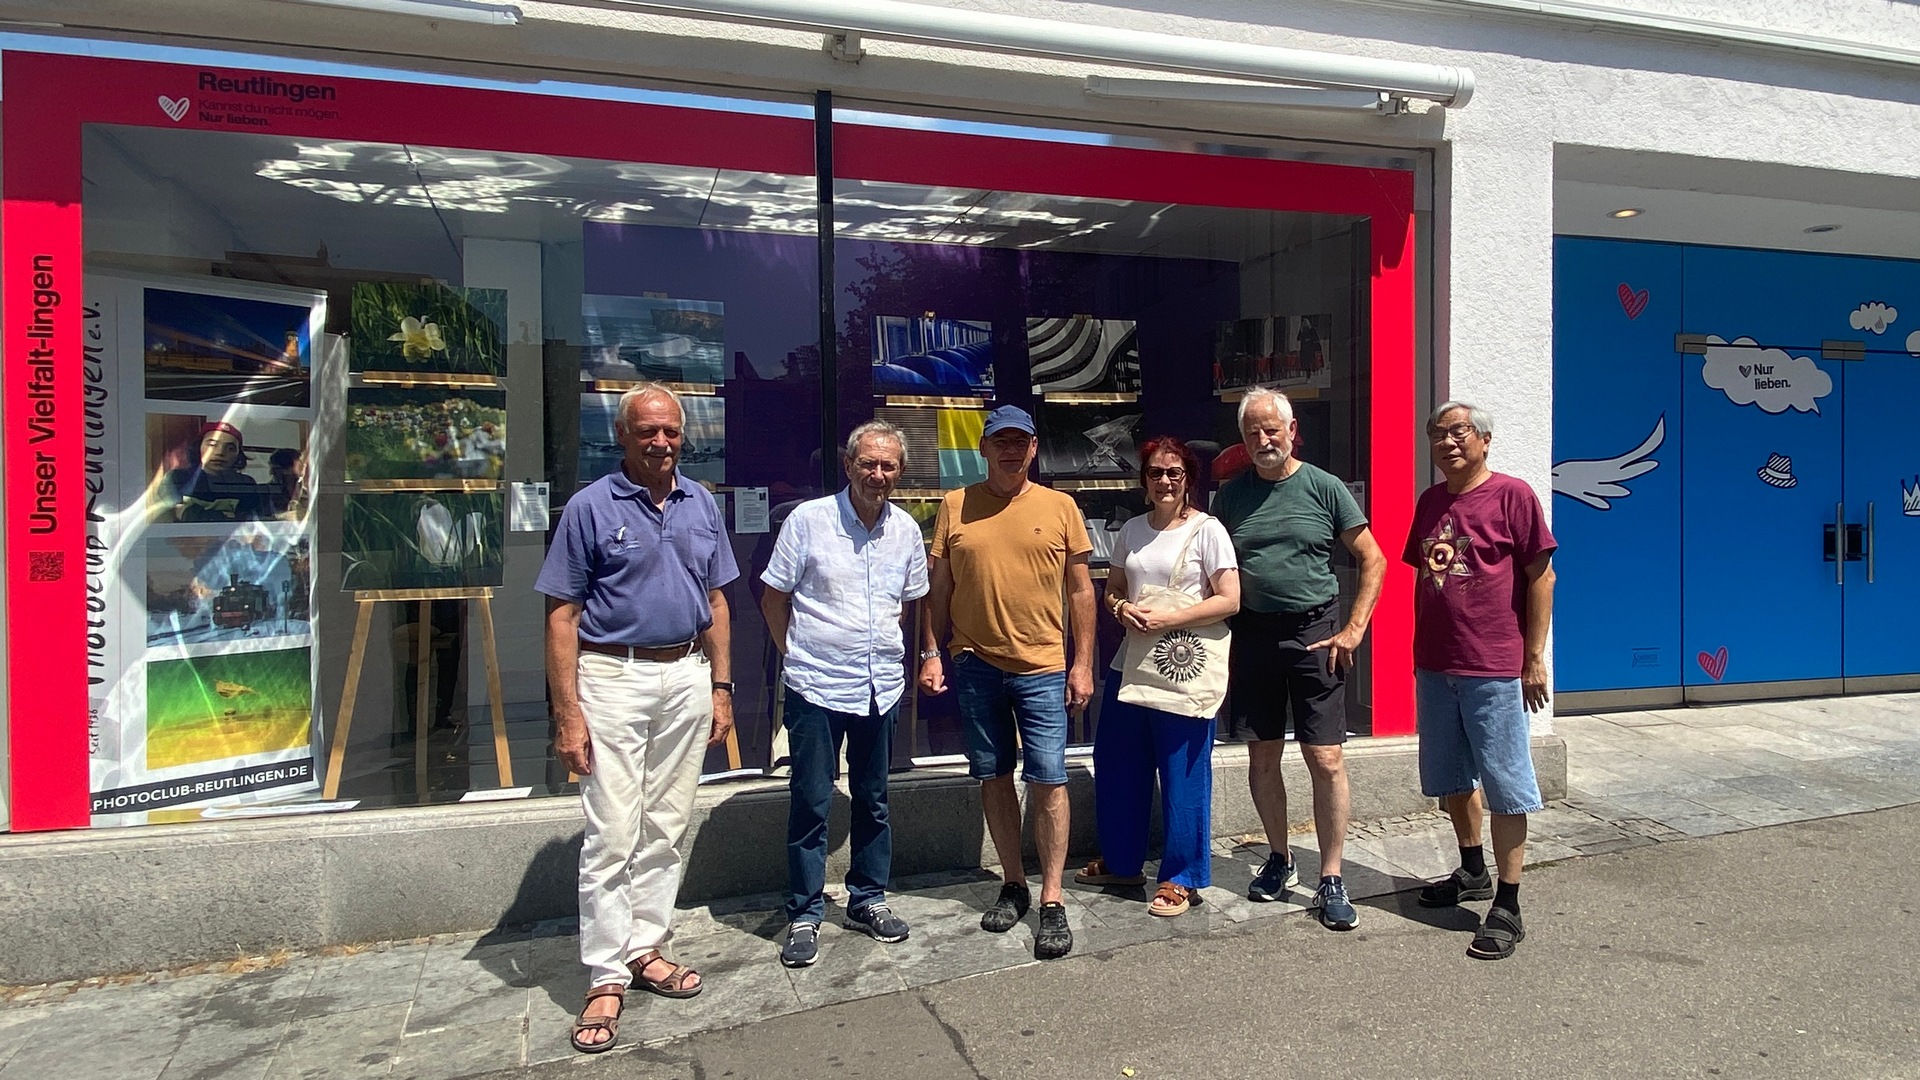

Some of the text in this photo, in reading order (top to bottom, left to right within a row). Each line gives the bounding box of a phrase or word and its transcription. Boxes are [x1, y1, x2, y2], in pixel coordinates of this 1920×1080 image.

[199, 71, 337, 103] Reutlingen
[198, 111, 271, 126] Nur lieben.
[199, 100, 342, 121] Kannst du nicht mögen.
[1753, 363, 1775, 375] Nur
[26, 254, 62, 534] Unser Vielfalt-lingen
[1754, 377, 1791, 390] lieben.
[88, 730, 101, 755] Seit
